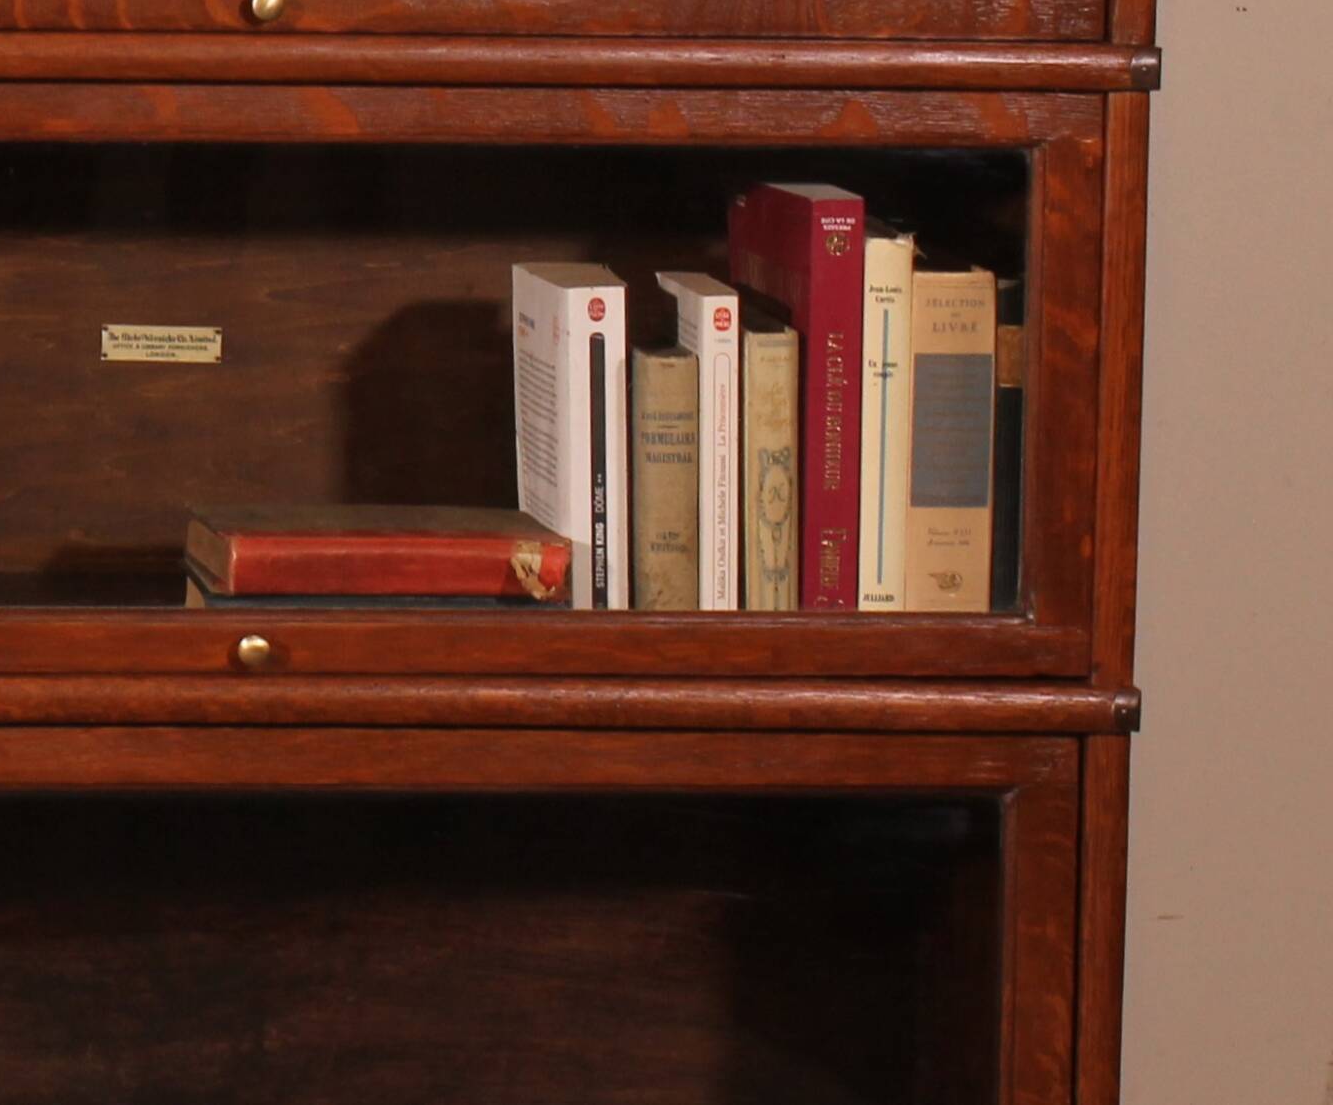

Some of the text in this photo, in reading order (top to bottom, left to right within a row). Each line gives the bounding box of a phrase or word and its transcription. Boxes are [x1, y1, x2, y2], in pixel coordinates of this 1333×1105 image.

[836, 217, 846, 225] LA
[933, 321, 979, 334] LIVRE
[826, 333, 844, 350] LA
[594, 522, 606, 546] KING
[594, 547, 606, 588] STEPHEN
